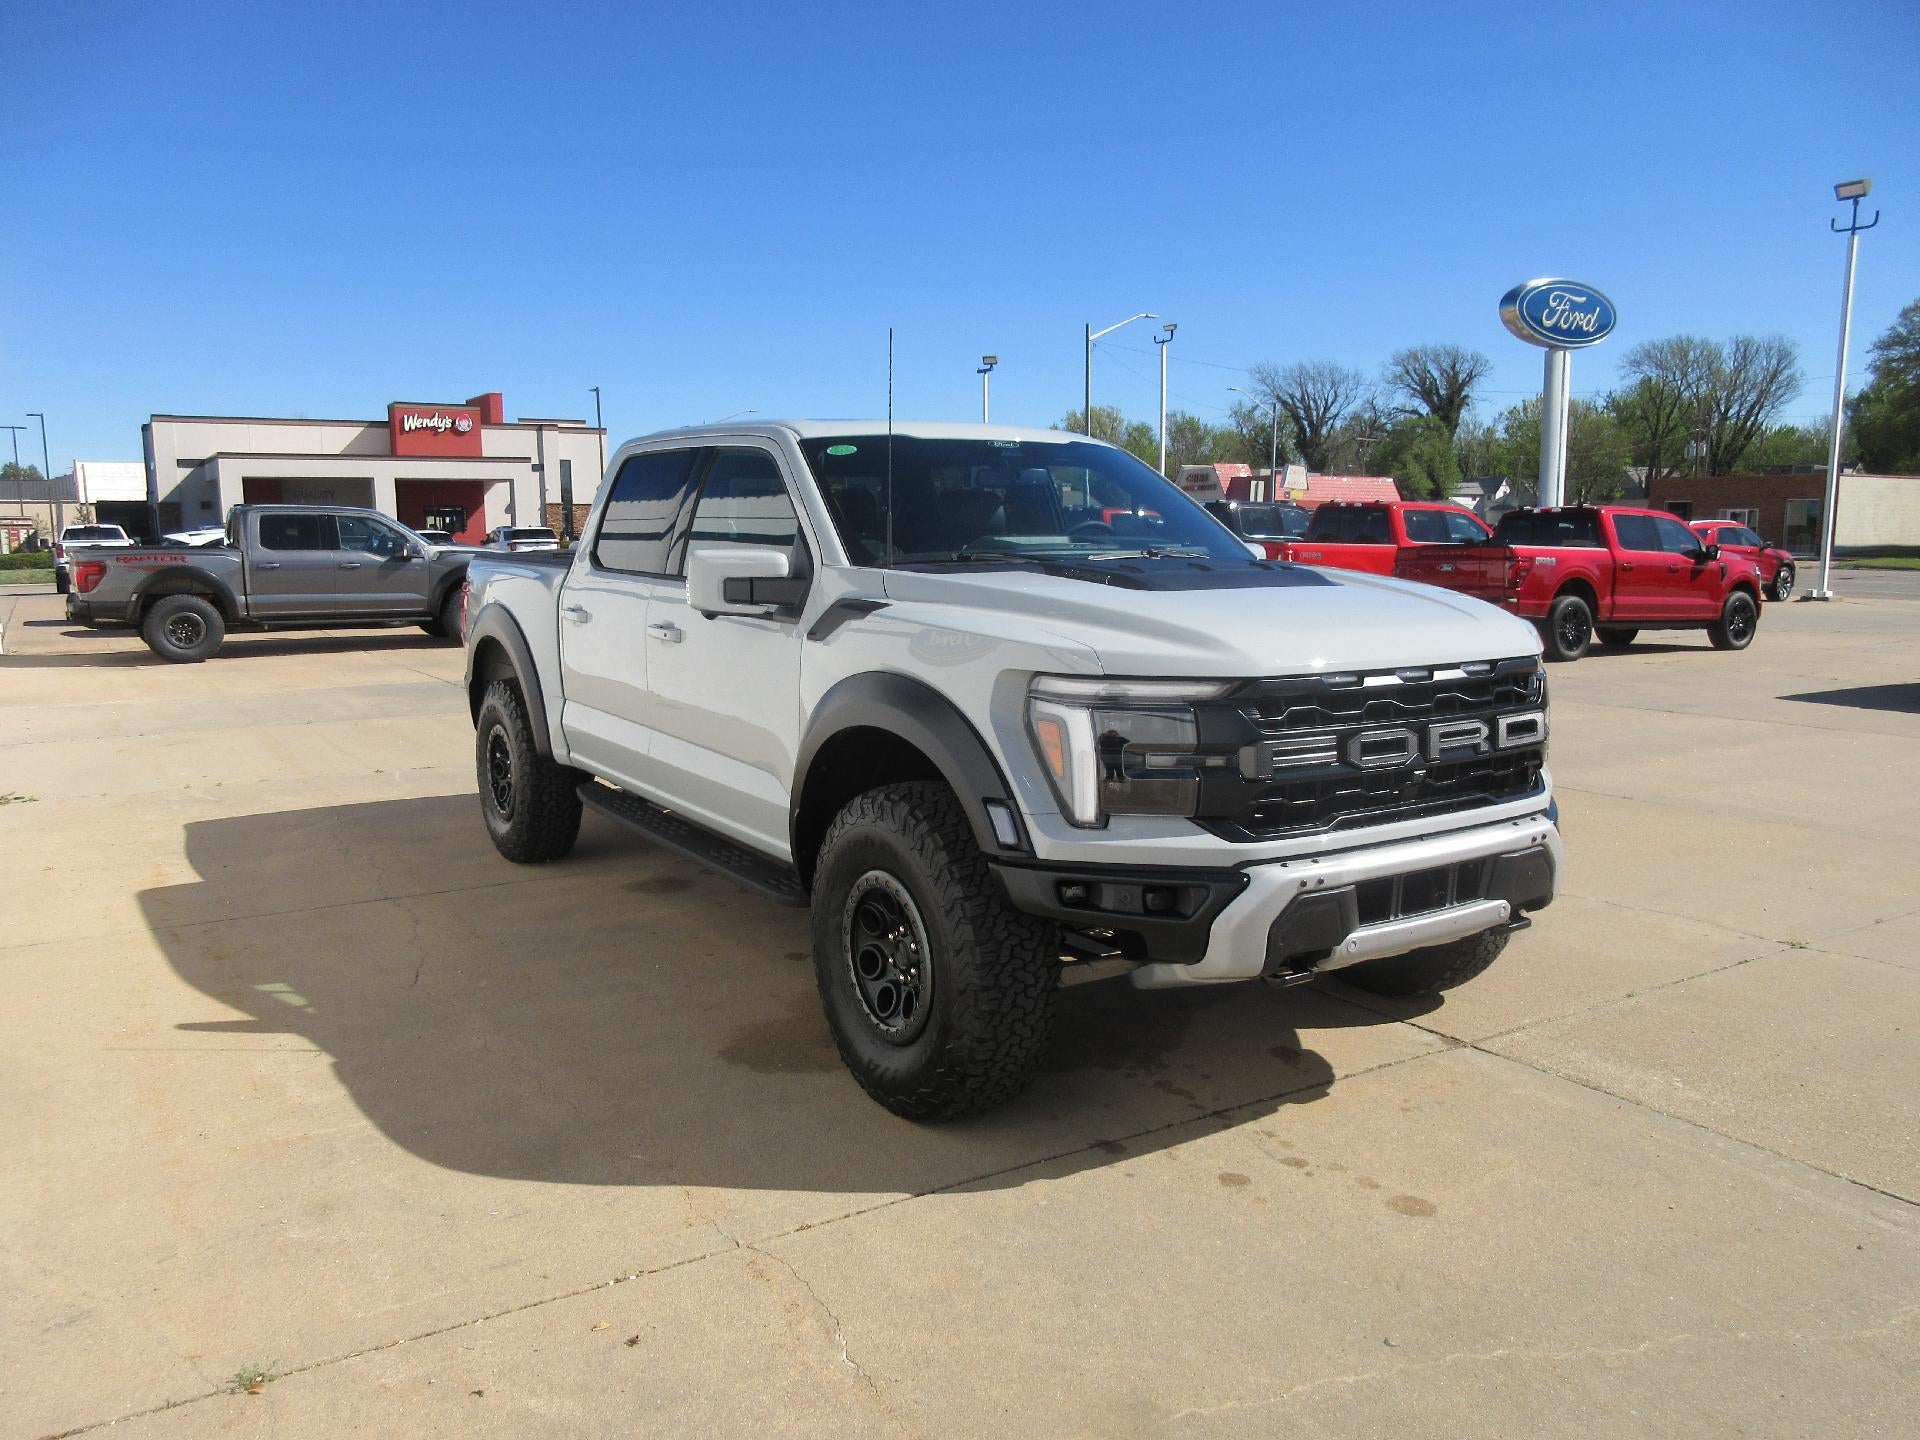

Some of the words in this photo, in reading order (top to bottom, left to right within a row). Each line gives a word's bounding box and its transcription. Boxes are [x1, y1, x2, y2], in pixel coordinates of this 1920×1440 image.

[1542, 291, 1600, 332] Ford
[403, 412, 453, 432] Wendy's
[115, 554, 188, 564] RAPTOR
[1239, 711, 1545, 781] FORD
